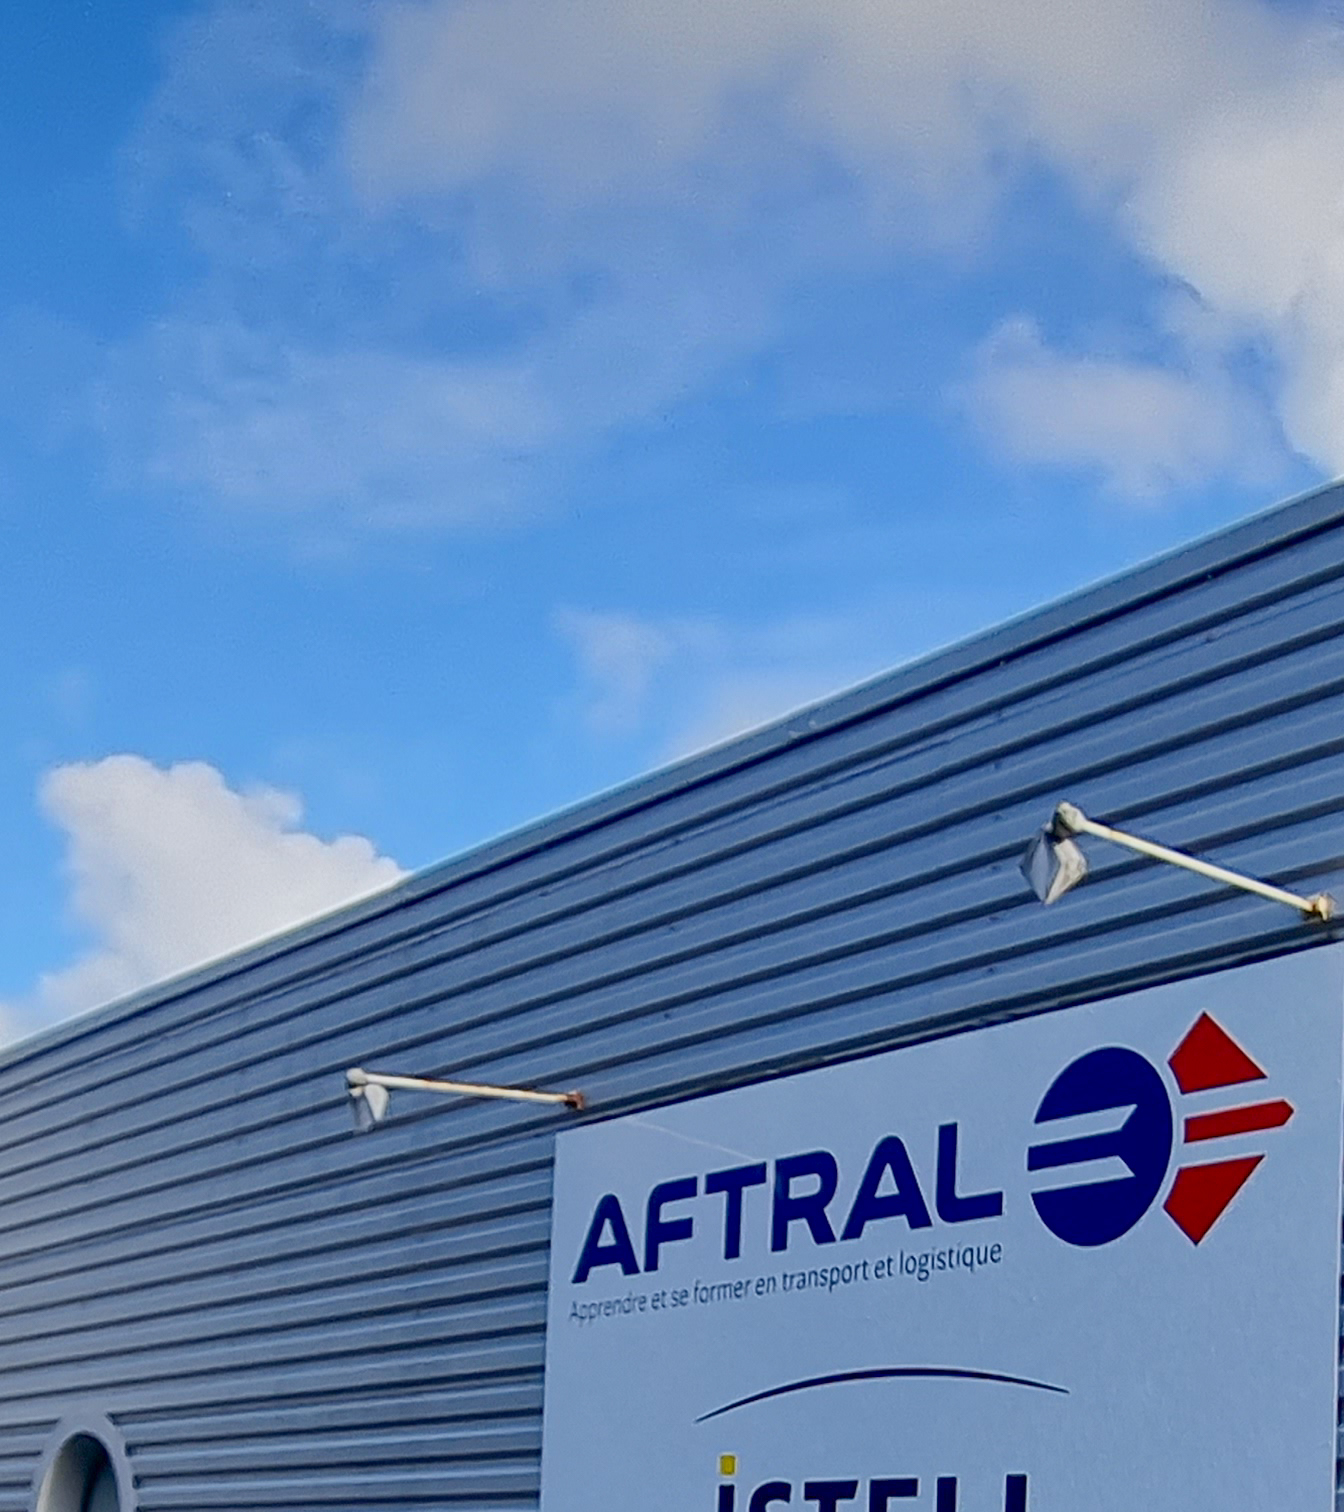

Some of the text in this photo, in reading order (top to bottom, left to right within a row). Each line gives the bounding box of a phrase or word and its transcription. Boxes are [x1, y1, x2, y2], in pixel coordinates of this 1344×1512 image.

[571, 1121, 1004, 1284] AFTRAL
[569, 1242, 1003, 1327] Apprendre et se former en transport et logistique
